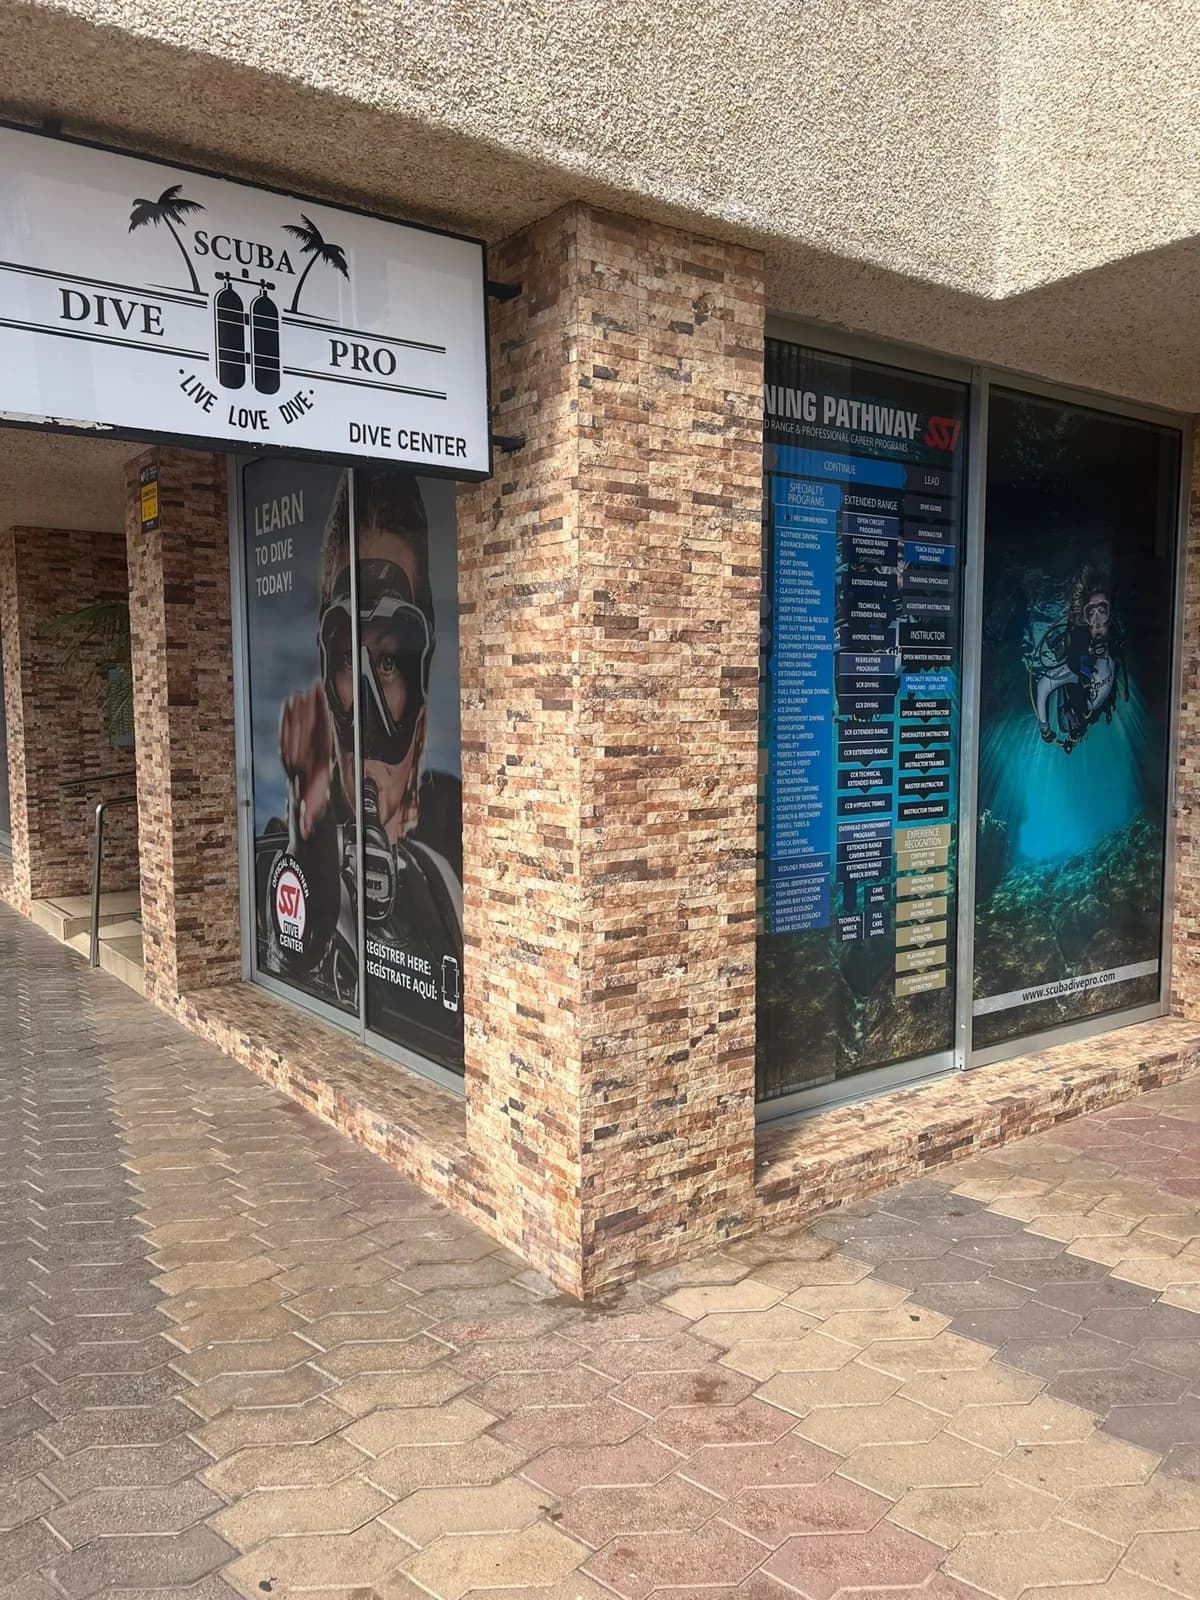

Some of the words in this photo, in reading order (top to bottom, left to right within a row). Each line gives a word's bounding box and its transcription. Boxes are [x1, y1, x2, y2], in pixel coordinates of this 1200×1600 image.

[193, 231, 296, 275] SCUBA
[59, 288, 164, 336] DIVE
[328, 339, 397, 376] PRO
[228, 405, 270, 430] LOVE
[823, 396, 918, 440] PATHWAY
[349, 422, 391, 448] DIVE
[398, 431, 467, 458] CENTER
[771, 421, 795, 434] RANGE
[796, 425, 801, 435] &
[802, 426, 849, 442] PROFESSIONAL
[851, 434, 874, 447] CAREER
[875, 438, 908, 453] PROGRAMS
[922, 416, 961, 451] SSI
[824, 462, 856, 474] CONTINUE
[790, 484, 824, 495] SPECIALTY
[925, 476, 939, 485] LEAD
[788, 494, 825, 506] PROGRAMS
[845, 495, 876, 508] EXTENDED
[878, 499, 898, 511] RANGE
[255, 490, 304, 536] LEARN
[256, 545, 269, 566] TO
[271, 538, 293, 562] DIVE
[256, 570, 293, 597] TODAY!
[911, 631, 945, 640] INSTRUCTOR
[905, 837, 941, 848] RECOGNITION
[907, 828, 940, 838] EXPERIENCE
[279, 884, 300, 919] SSI
[284, 923, 299, 938] DIVE
[280, 935, 303, 953] CENTER
[407, 956, 431, 976] HERE:
[412, 980, 438, 1001] AQUÍ:
[1022, 971, 1115, 1001] www.scubadivepro.com
